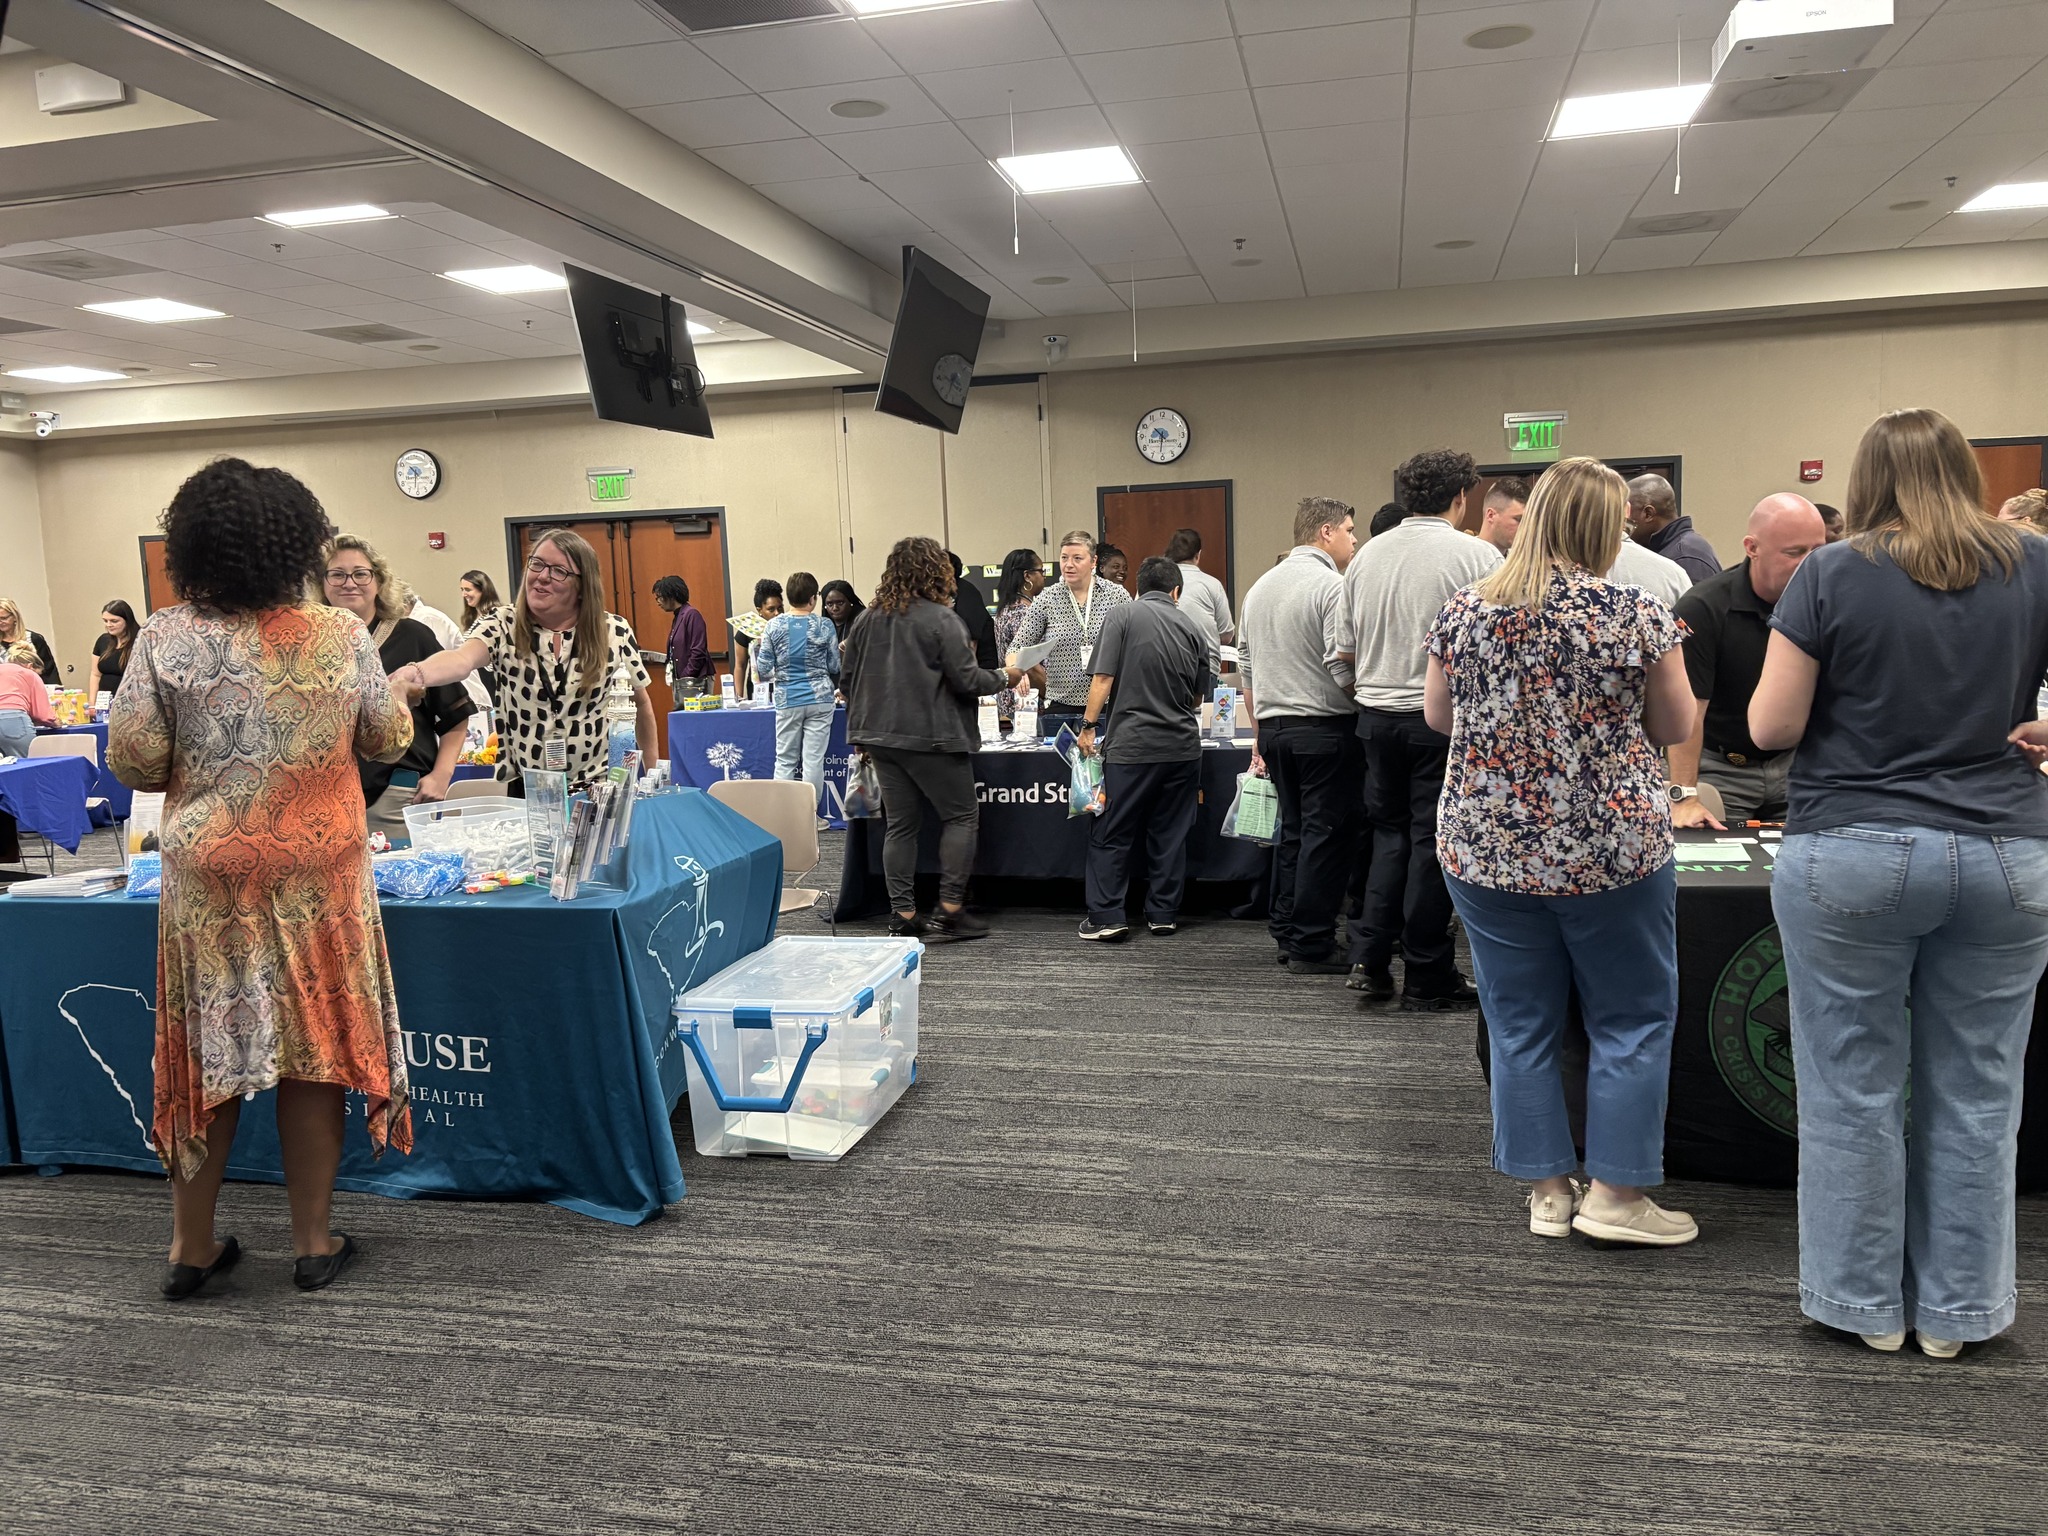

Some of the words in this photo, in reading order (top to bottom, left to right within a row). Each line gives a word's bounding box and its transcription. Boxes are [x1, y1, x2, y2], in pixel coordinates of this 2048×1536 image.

[1518, 421, 1555, 448] EXIT
[597, 475, 625, 499] EXIT
[836, 768, 847, 777] of
[974, 782, 1040, 803] Grand
[409, 1086, 485, 1108] HEALTH
